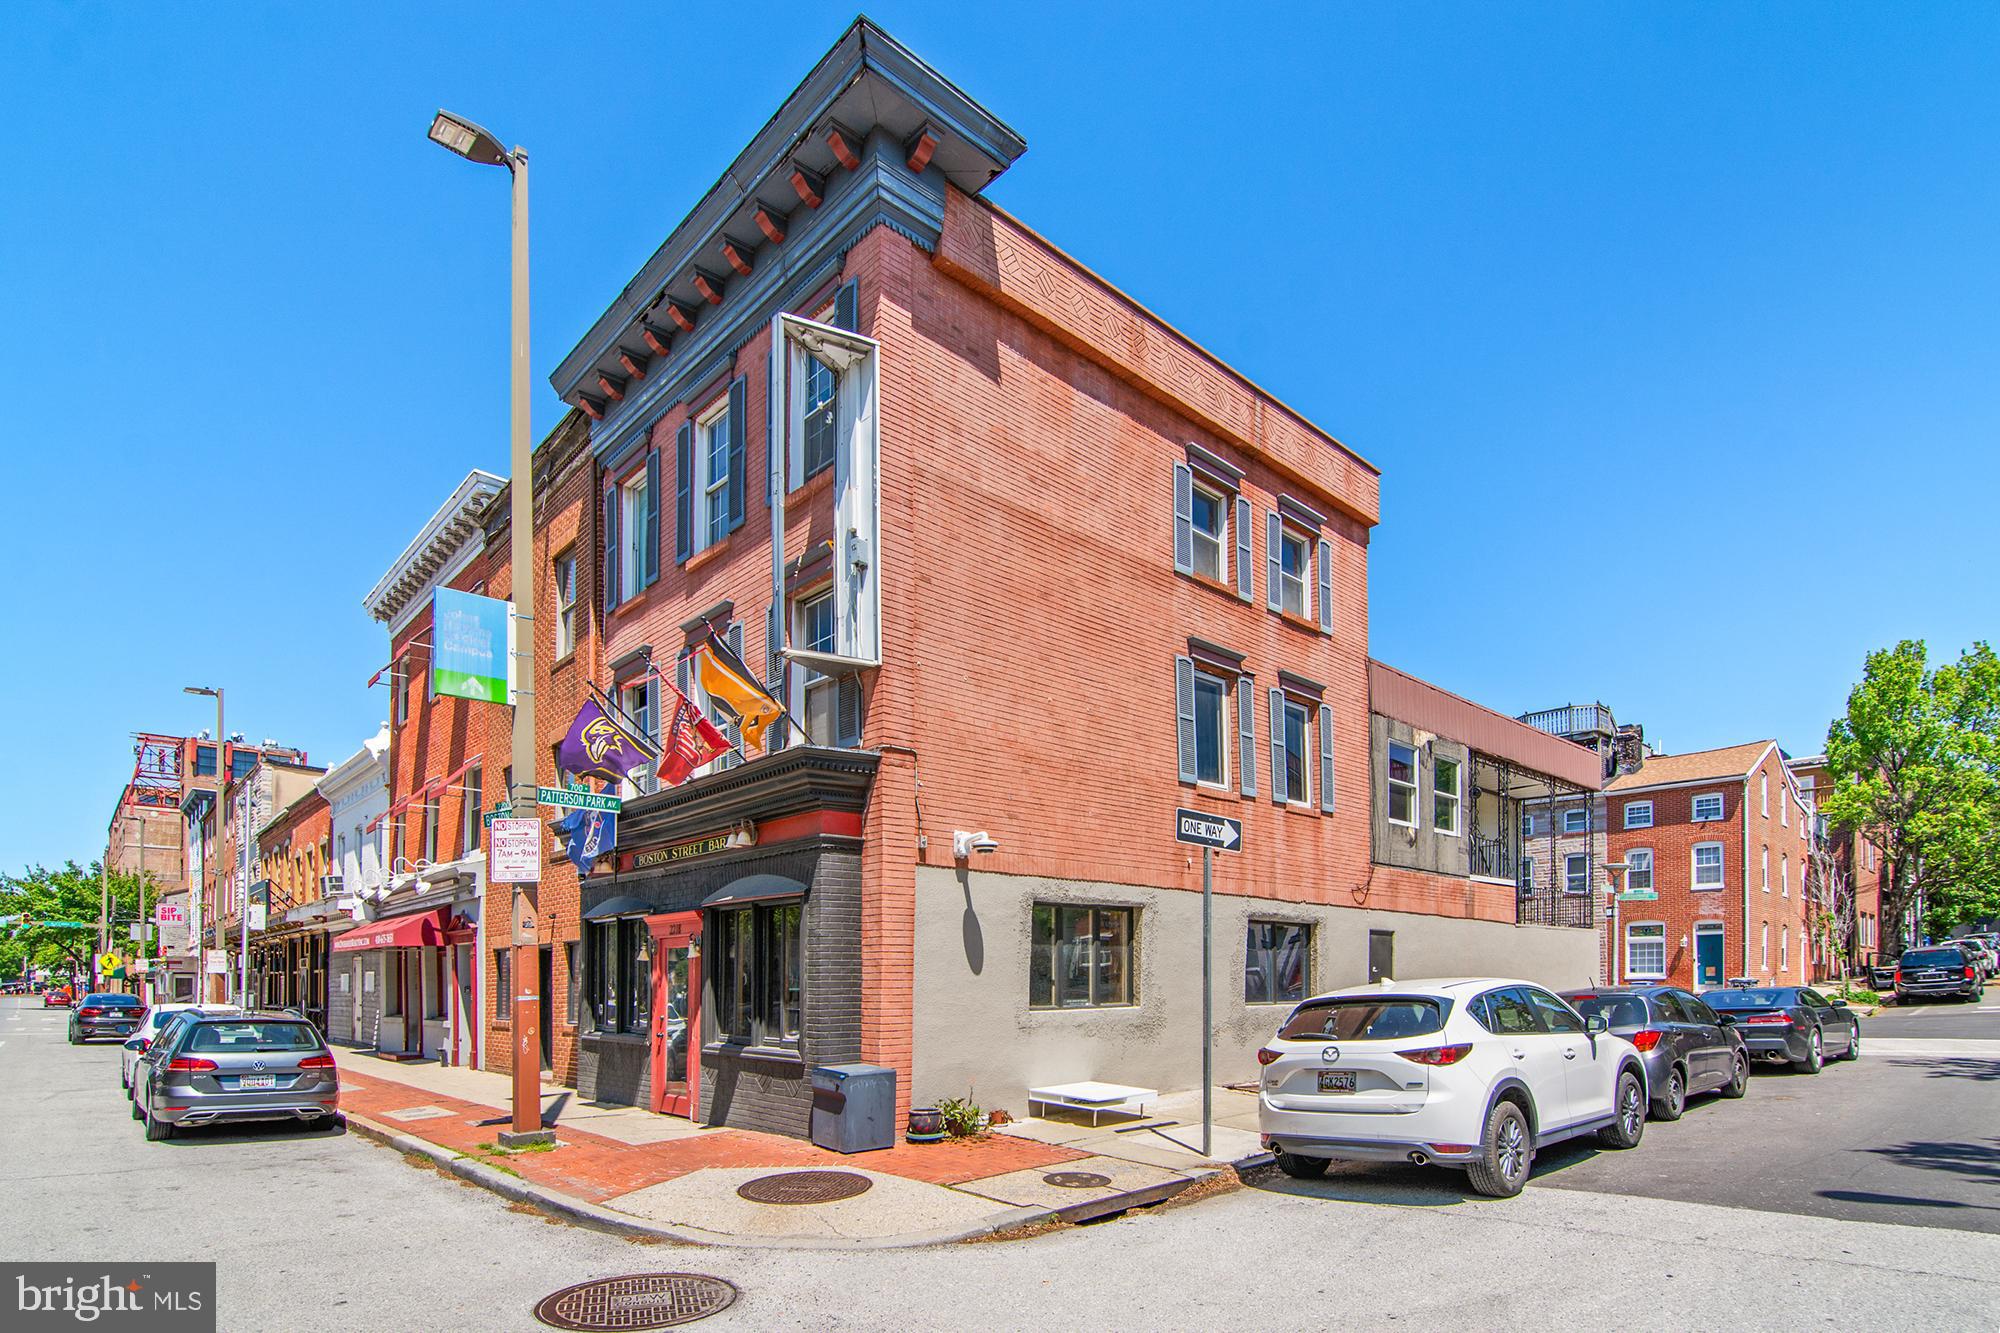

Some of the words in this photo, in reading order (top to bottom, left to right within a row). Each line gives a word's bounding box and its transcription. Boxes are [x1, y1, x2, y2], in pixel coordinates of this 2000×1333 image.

[570, 784, 583, 792] 700
[541, 790, 584, 806] PATTERSON
[586, 796, 606, 809] PARK
[495, 821, 506, 831] NO
[507, 821, 538, 831] STOPPING
[1184, 820, 1202, 835] ONE
[1205, 824, 1223, 839] WAY
[496, 838, 507, 848] NO
[508, 838, 538, 848] STOPPING
[639, 850, 668, 866] BOSTON
[672, 843, 704, 859] STREET
[708, 837, 727, 851] BAR
